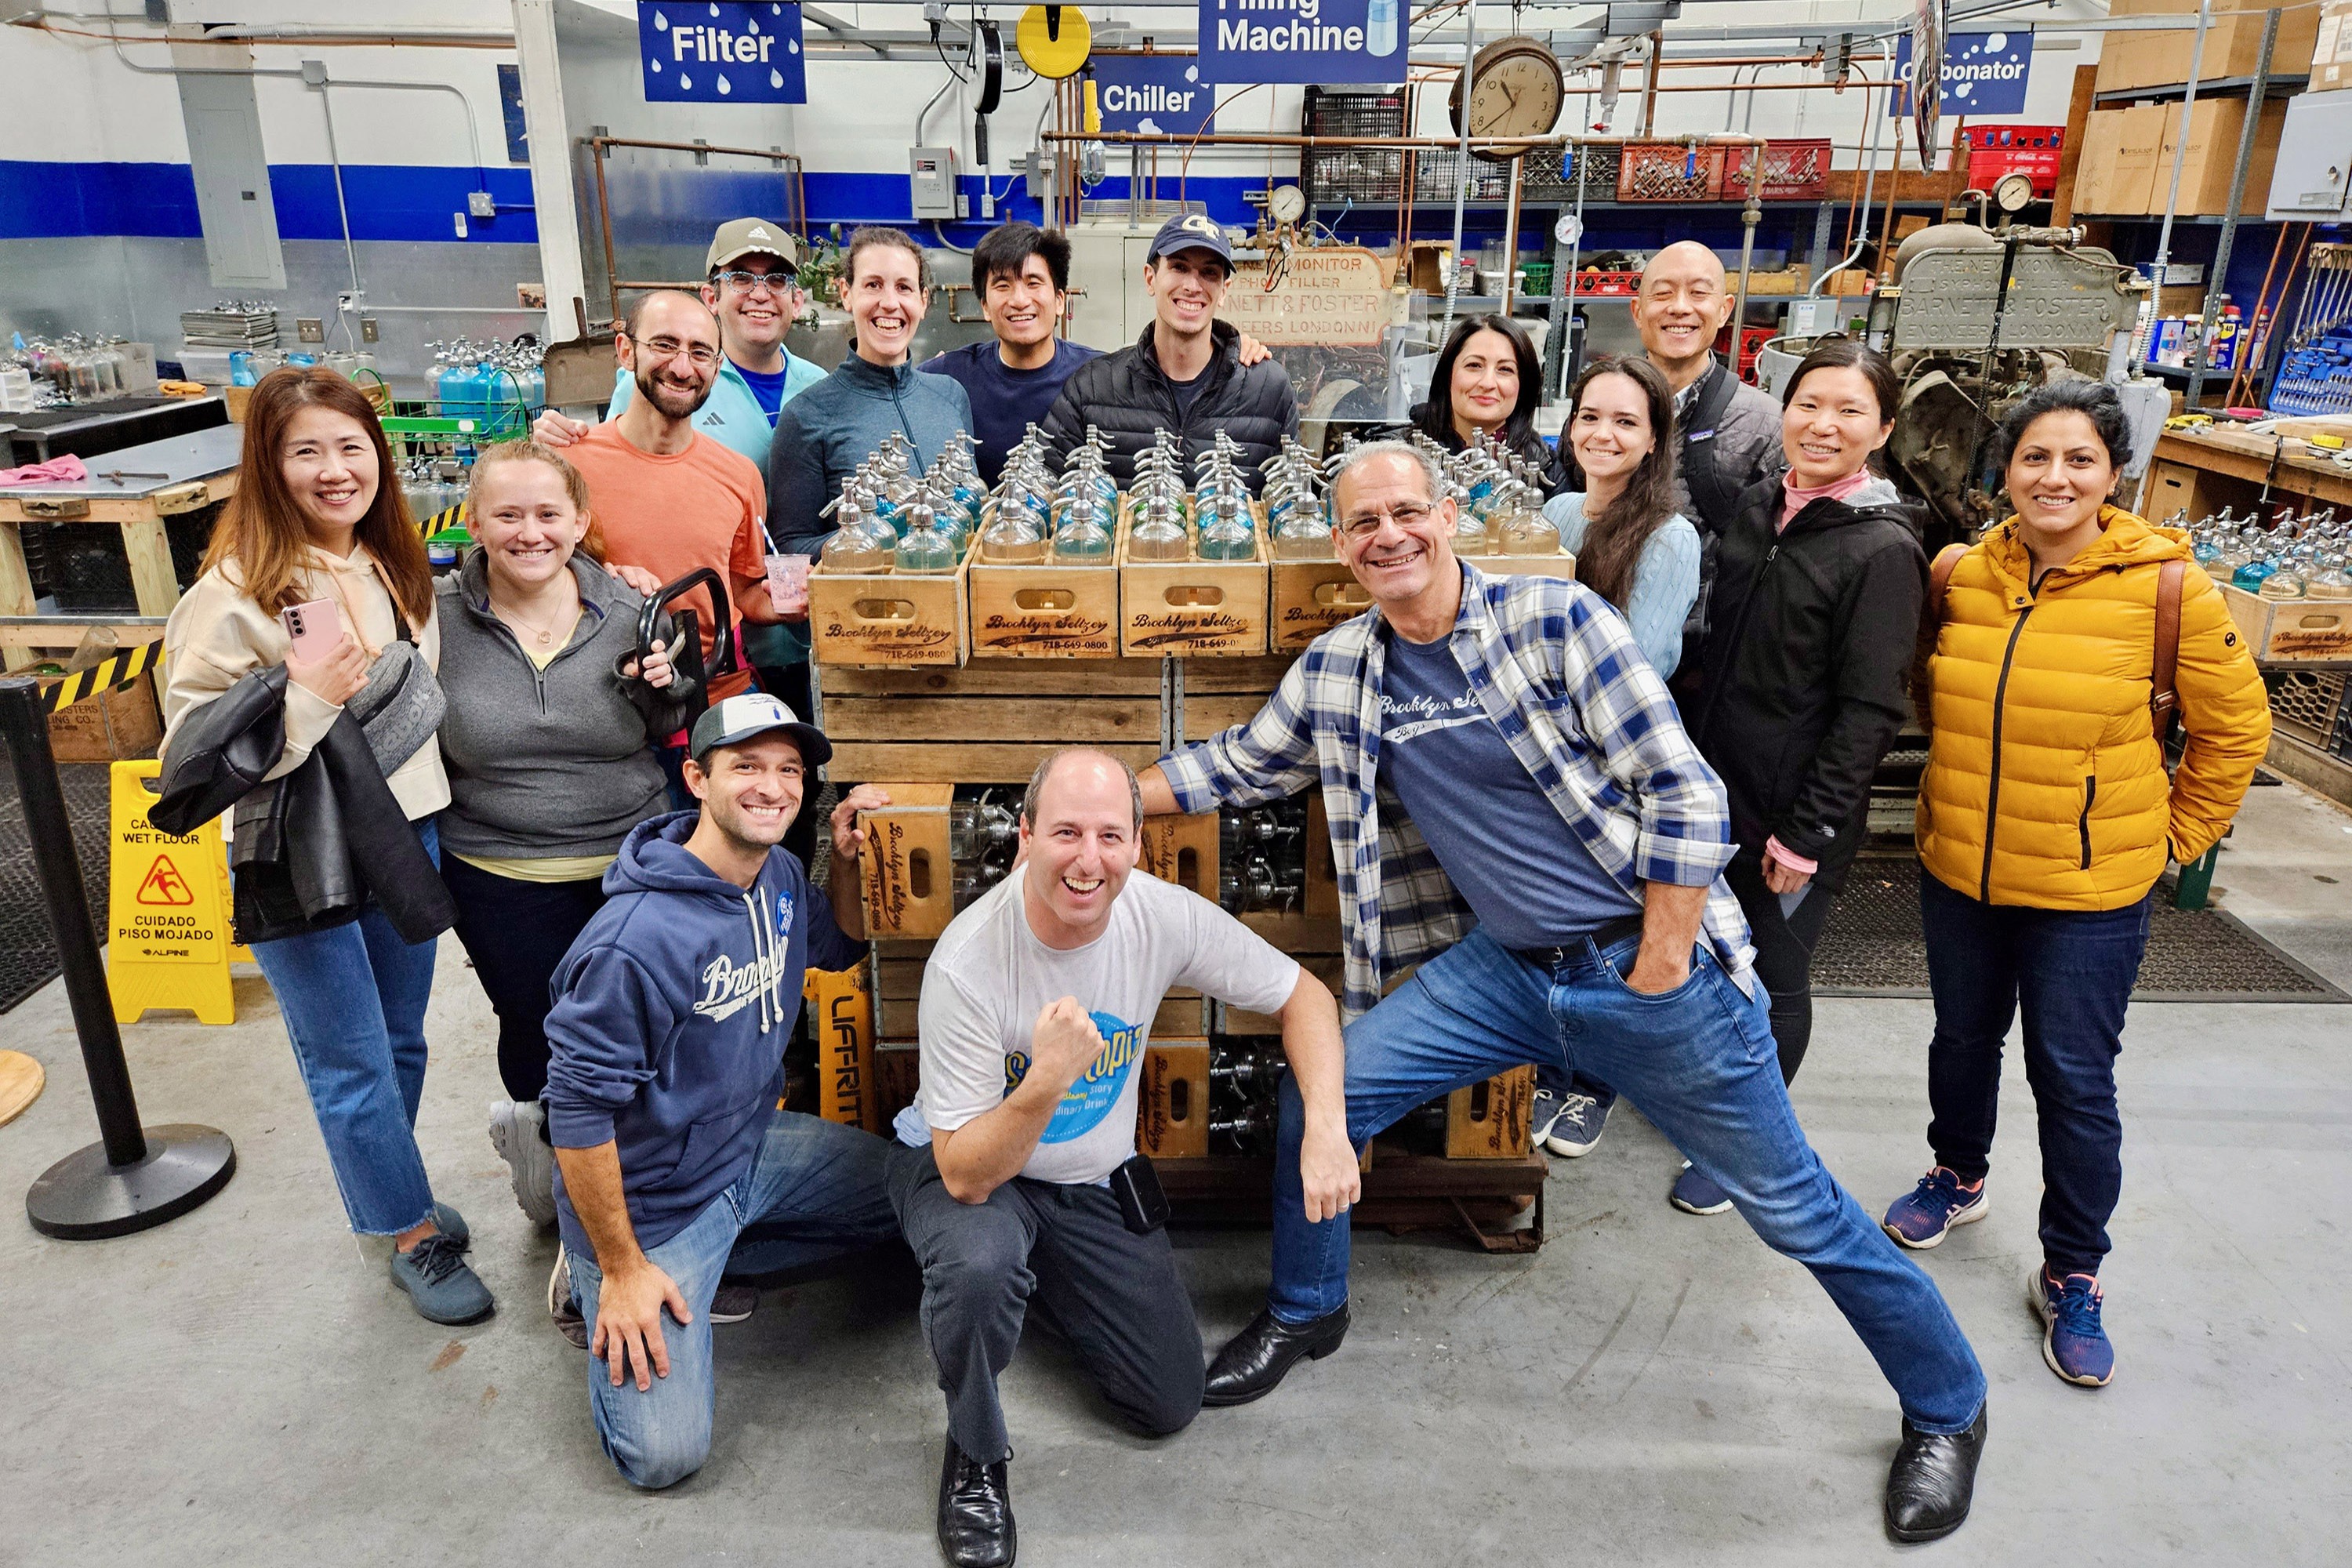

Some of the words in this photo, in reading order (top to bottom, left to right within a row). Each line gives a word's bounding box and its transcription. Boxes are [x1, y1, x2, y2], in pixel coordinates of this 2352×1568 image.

[1218, 17, 1364, 52] Machine
[672, 25, 775, 63] Filter
[1501, 67, 1510, 77] 11
[1517, 63, 1526, 72] 12
[1900, 61, 2024, 82] Cbonator
[1486, 81, 1497, 90] 10
[1541, 82, 1548, 92] 2
[1104, 84, 1195, 112] Chiller
[1478, 98, 1485, 108] 9
[1541, 102, 1548, 111] 3
[1477, 115, 1484, 126] 8
[1531, 119, 1539, 129] 4
[1287, 258, 1362, 271] MONITOR
[1232, 278, 1279, 289] YPHON
[1290, 277, 1341, 289] FILLER
[1228, 295, 1280, 313] NETT
[1299, 295, 1379, 314] FOSTER
[2024, 297, 2108, 318] FOSTER
[1905, 324, 1992, 339] ENGINEER
[1283, 607, 1350, 626] Brooklyn
[985, 615, 1051, 633] Brooklyn
[1054, 615, 1109, 633] Seltzer
[1131, 614, 1197, 633] Brooklyn
[825, 623, 892, 642] Brooklyn
[895, 624, 952, 643] Seltzer
[1043, 641, 1108, 649] 718-649-0800
[1380, 695, 1450, 719] Brooklyn
[76, 714, 95, 724] CO.
[123, 833, 151, 844] WET
[155, 833, 200, 845] FLOOR
[886, 822, 904, 883] Brooklyn
[135, 916, 196, 927] CUIDADO
[119, 929, 151, 939] PISO
[155, 930, 214, 940] MOJADO
